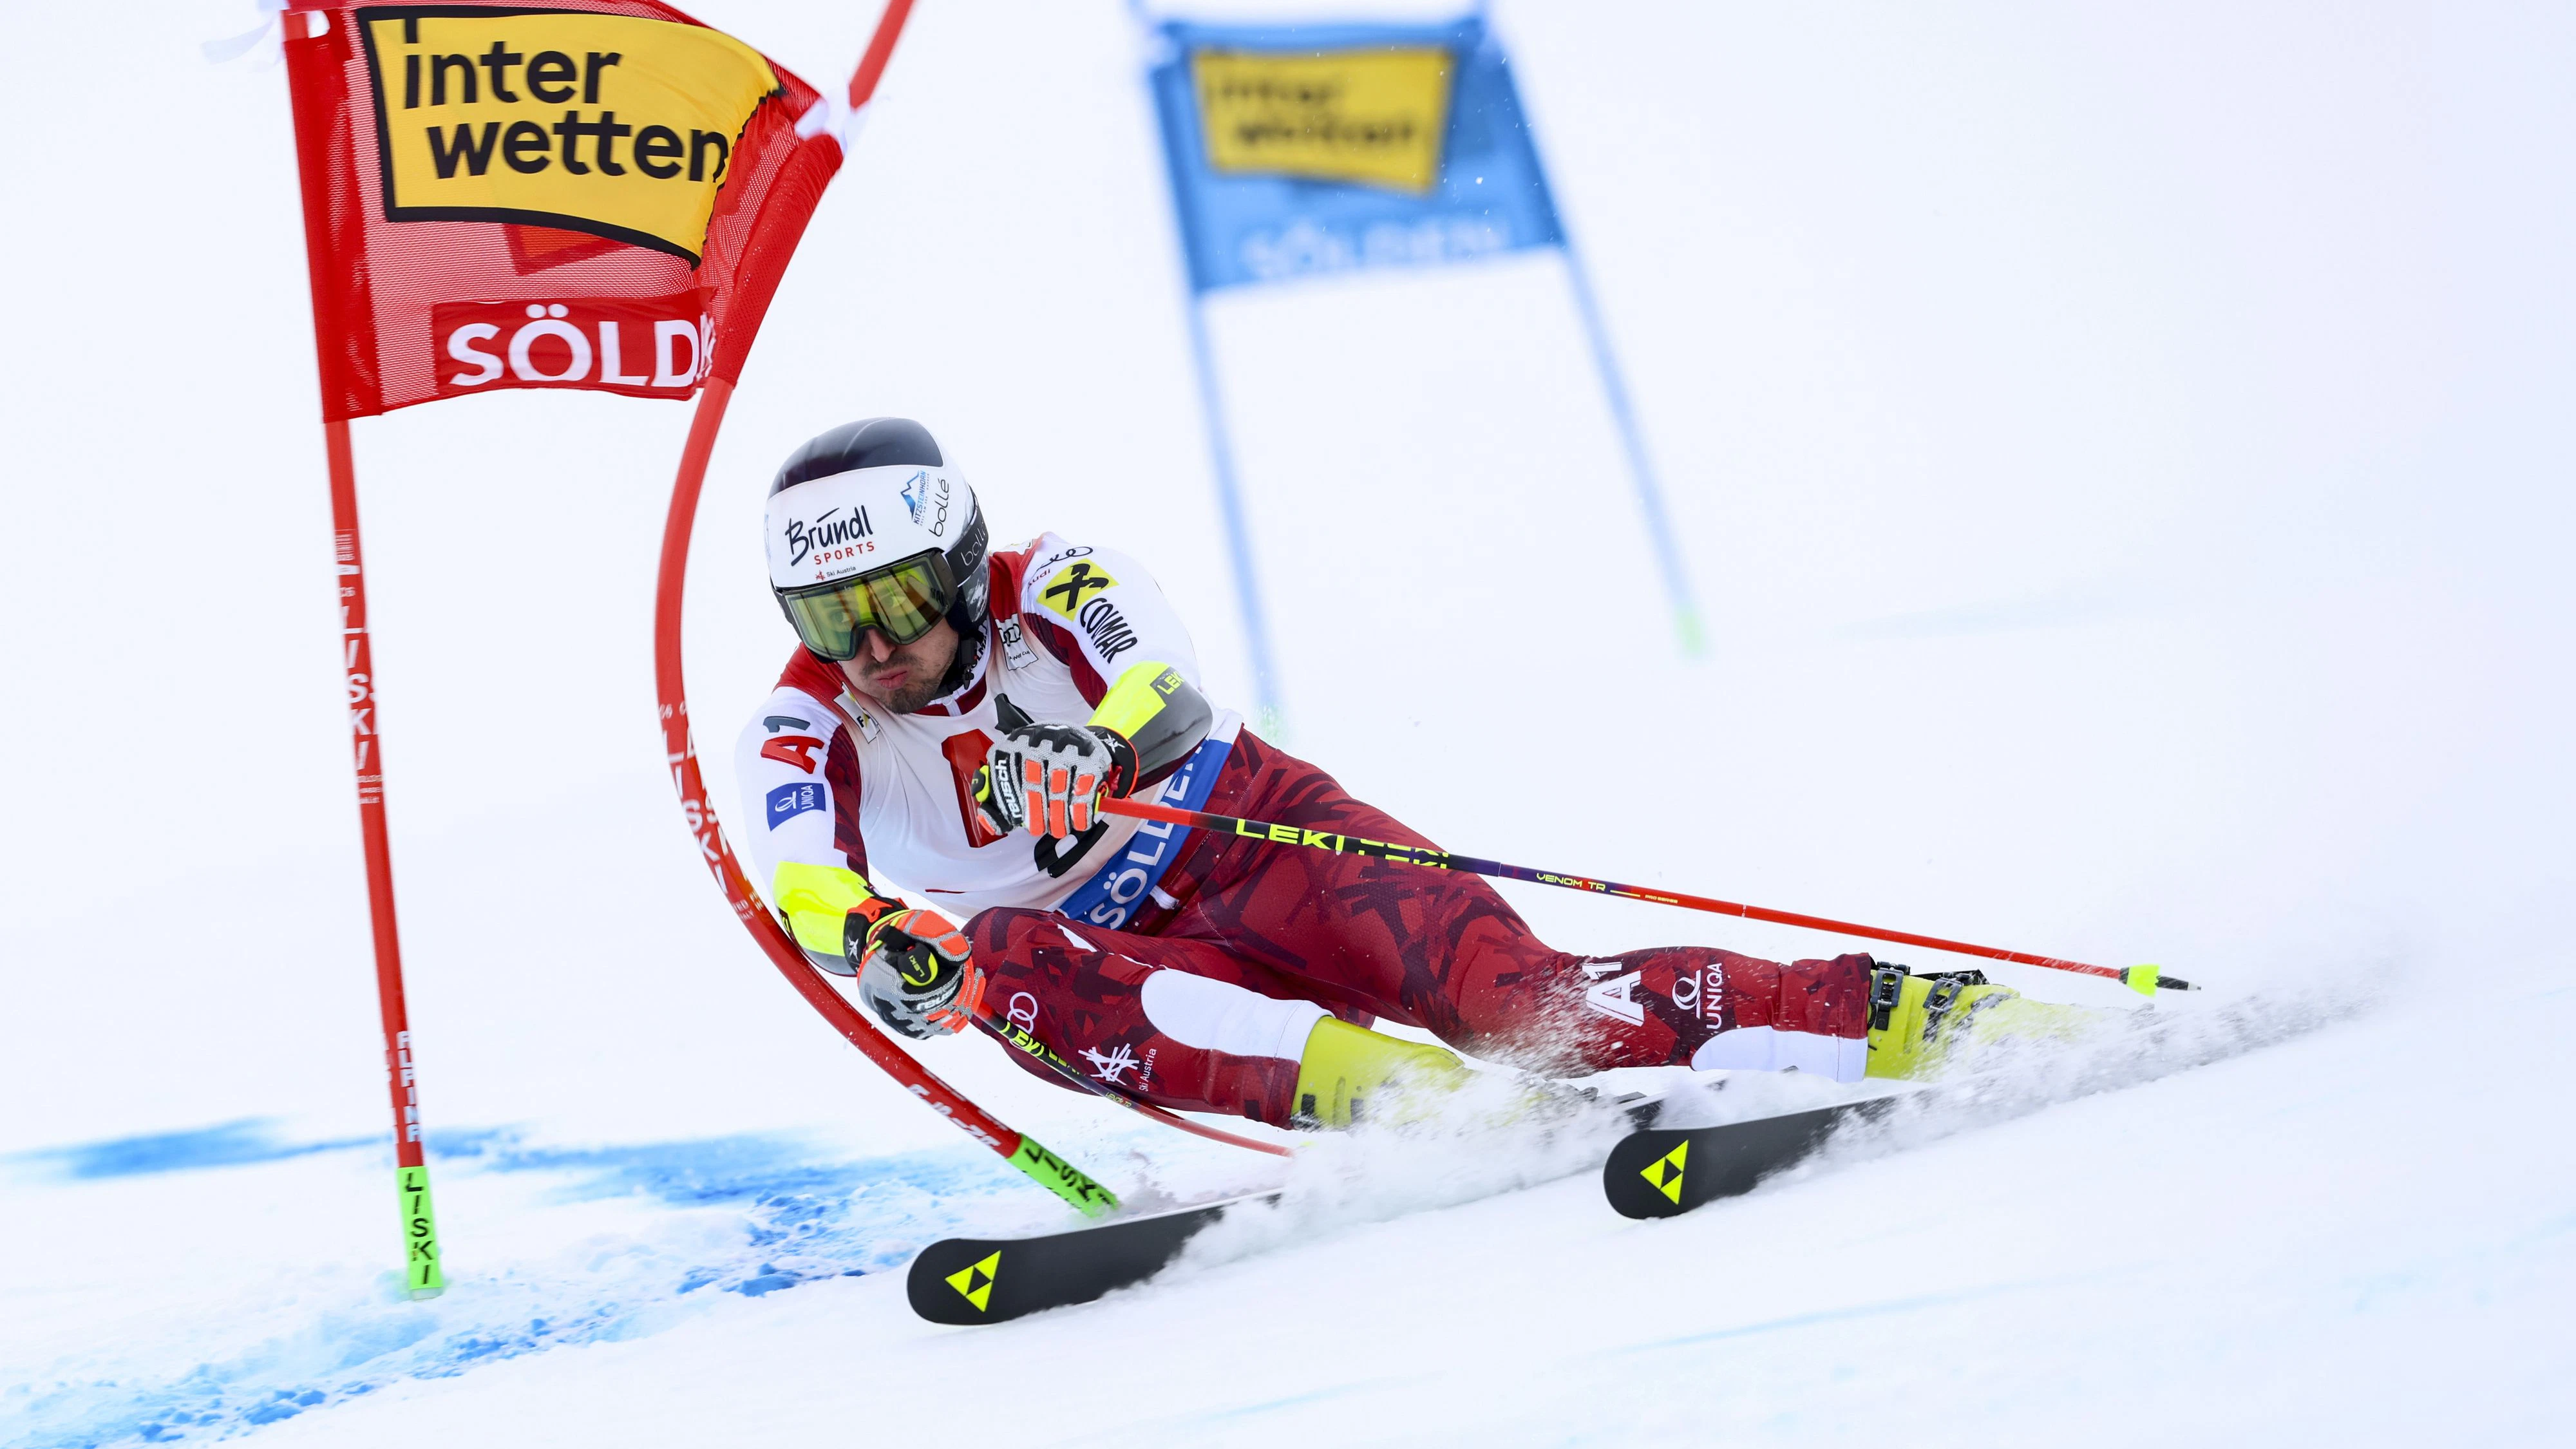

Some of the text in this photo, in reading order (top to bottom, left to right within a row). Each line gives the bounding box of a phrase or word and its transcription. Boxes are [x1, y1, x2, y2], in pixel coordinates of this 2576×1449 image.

[403, 18, 621, 109] inter
[426, 111, 731, 183] wetten
[928, 478, 949, 537] bollé
[814, 541, 875, 565] SPORTS
[837, 566, 857, 574] Austria
[761, 715, 825, 775] A1
[800, 784, 815, 810] UNIQA
[995, 759, 1022, 818] reusch
[1235, 818, 1345, 851] LEKI
[1537, 872, 1606, 891] VENOM TR
[1582, 961, 1645, 1027] A1
[1706, 962, 1723, 1030] UNIQA
[1138, 1048, 1157, 1092] Ski Austria
[1025, 1146, 1112, 1206] LISKI
[403, 1172, 435, 1285] LISKI
